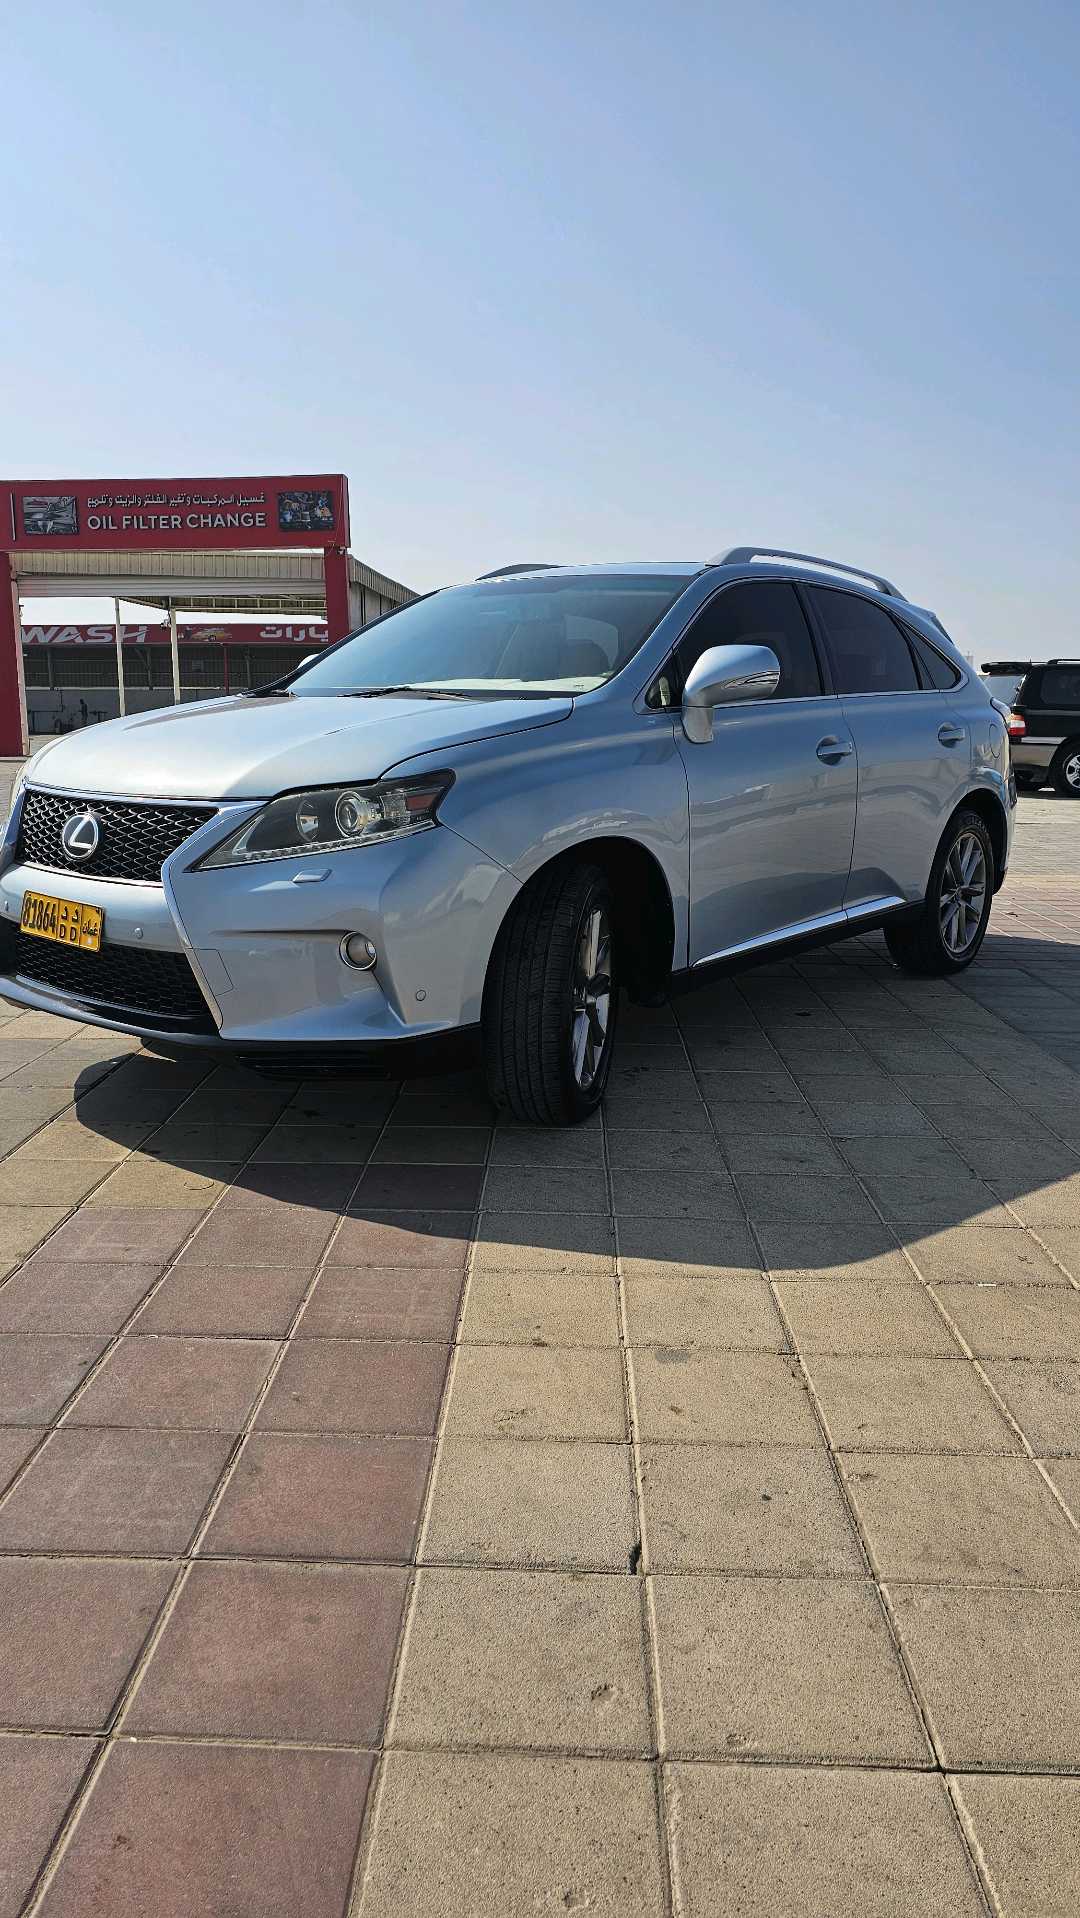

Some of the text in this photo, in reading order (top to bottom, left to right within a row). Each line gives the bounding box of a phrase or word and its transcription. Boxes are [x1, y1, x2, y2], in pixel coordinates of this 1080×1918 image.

[236, 491, 265, 507] غسيل
[87, 512, 267, 530] OIL FILTER CHANGE
[21, 625, 150, 643] WASH
[259, 626, 329, 642] يارات
